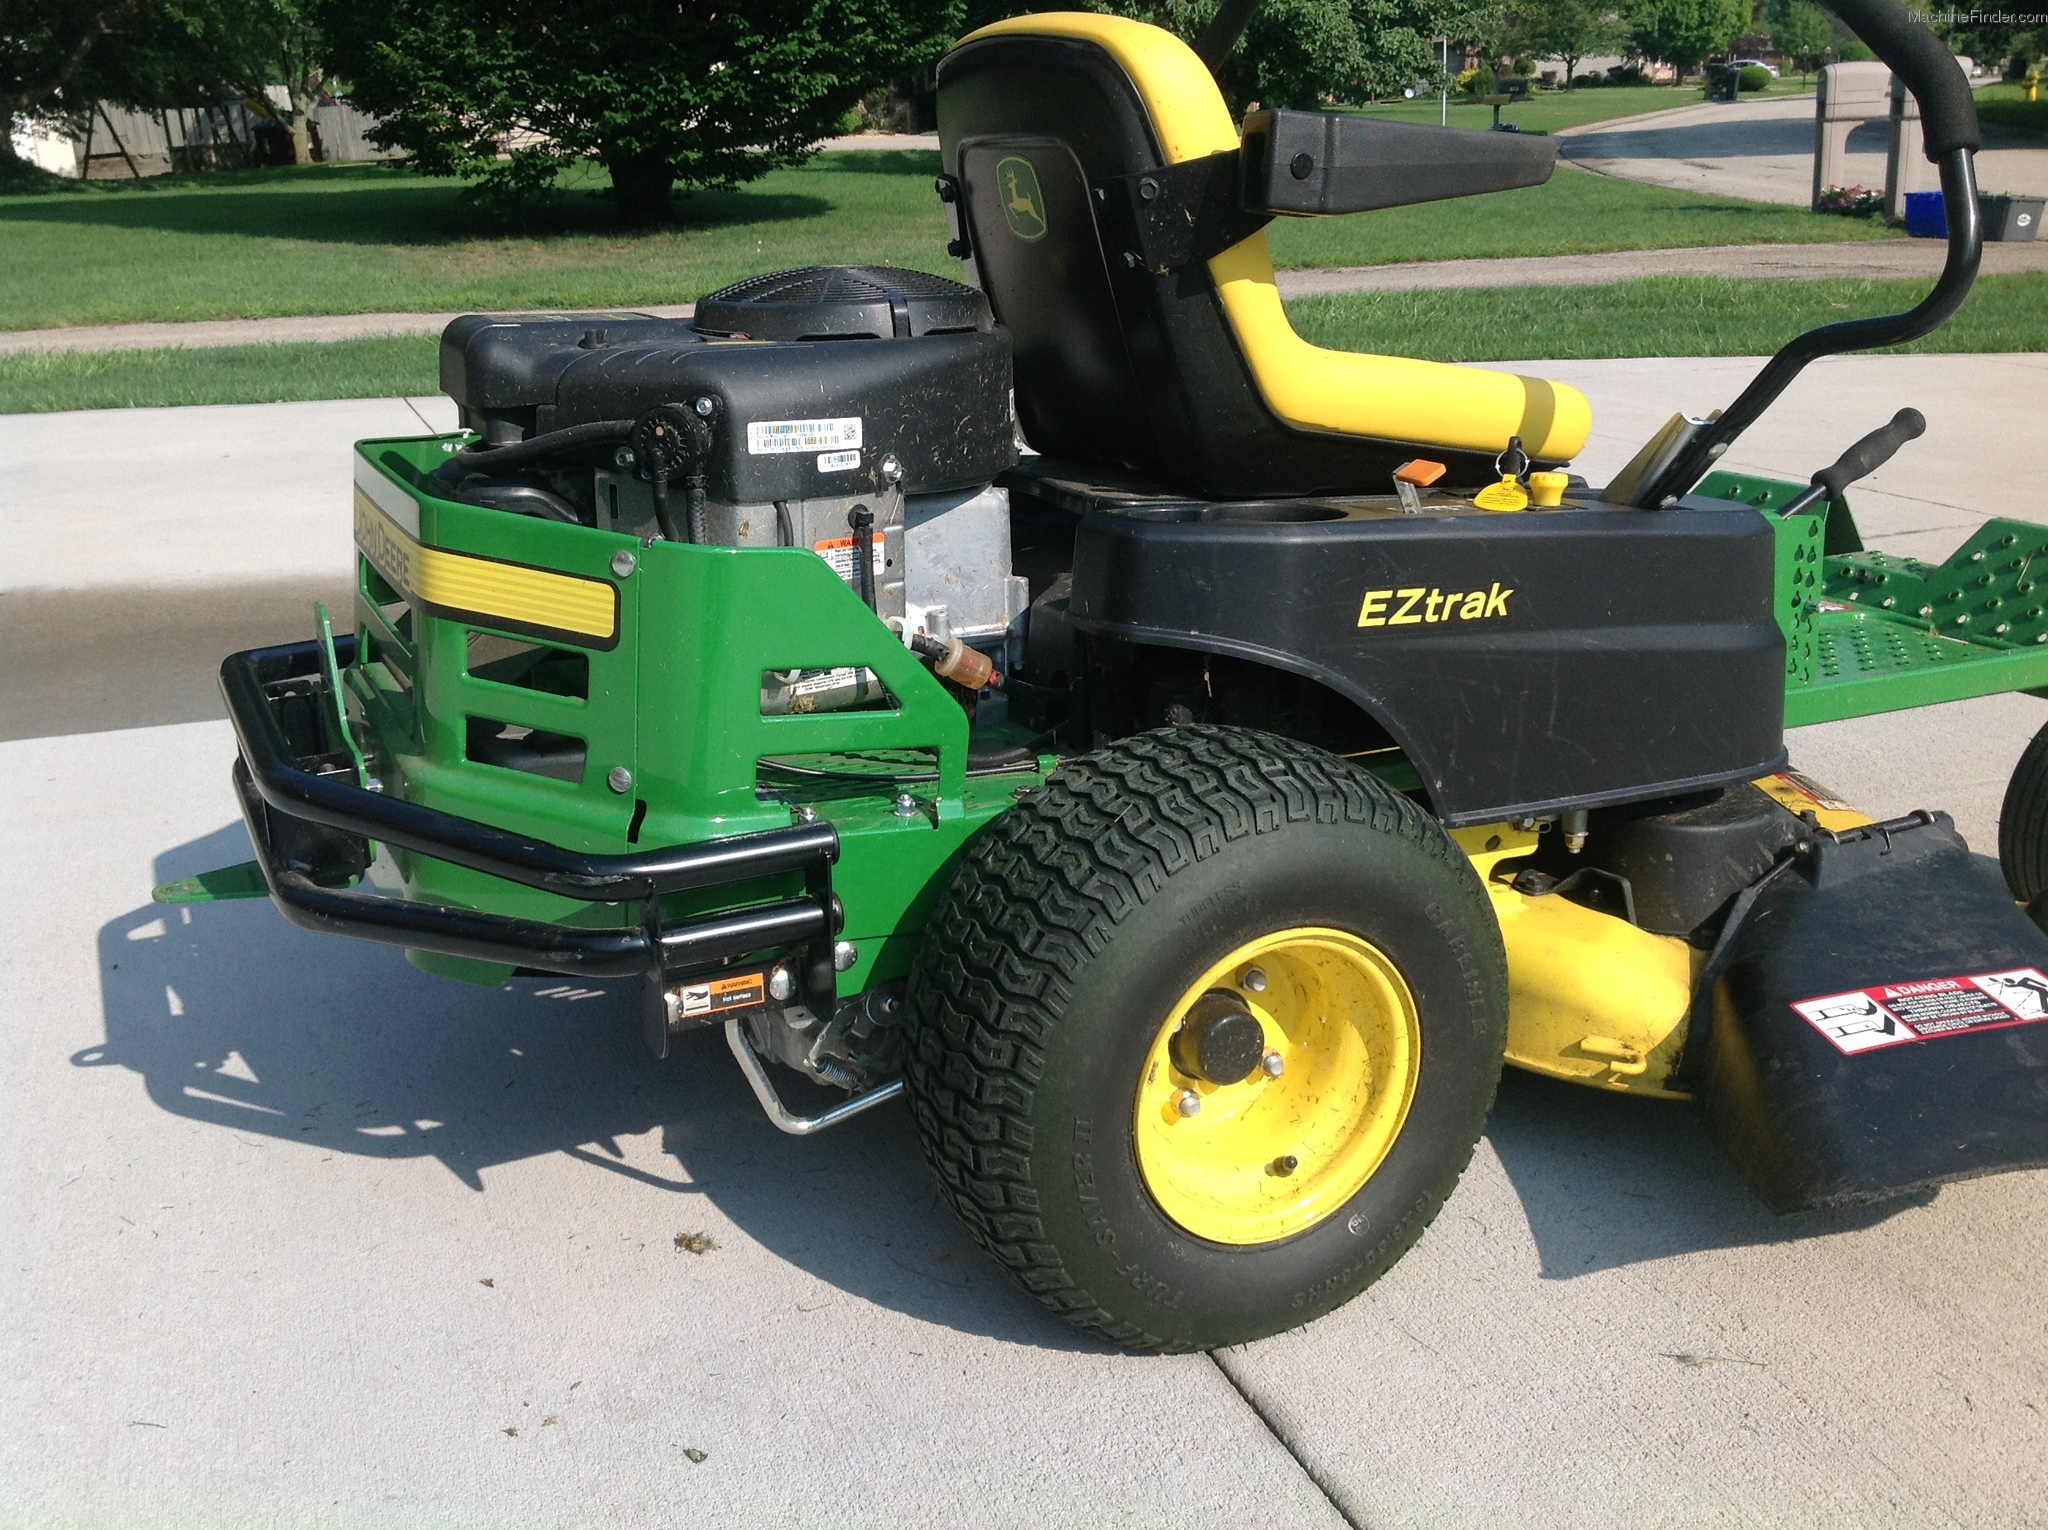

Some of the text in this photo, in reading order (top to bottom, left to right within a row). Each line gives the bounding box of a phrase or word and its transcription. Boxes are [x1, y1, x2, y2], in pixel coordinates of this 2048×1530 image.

[378, 521, 410, 590] DEERE
[1357, 582, 1515, 628] EZtrak
[726, 979, 752, 989] WARNING
[1424, 902, 1488, 1039] CARLISLE
[1896, 980, 1961, 995] DANGER
